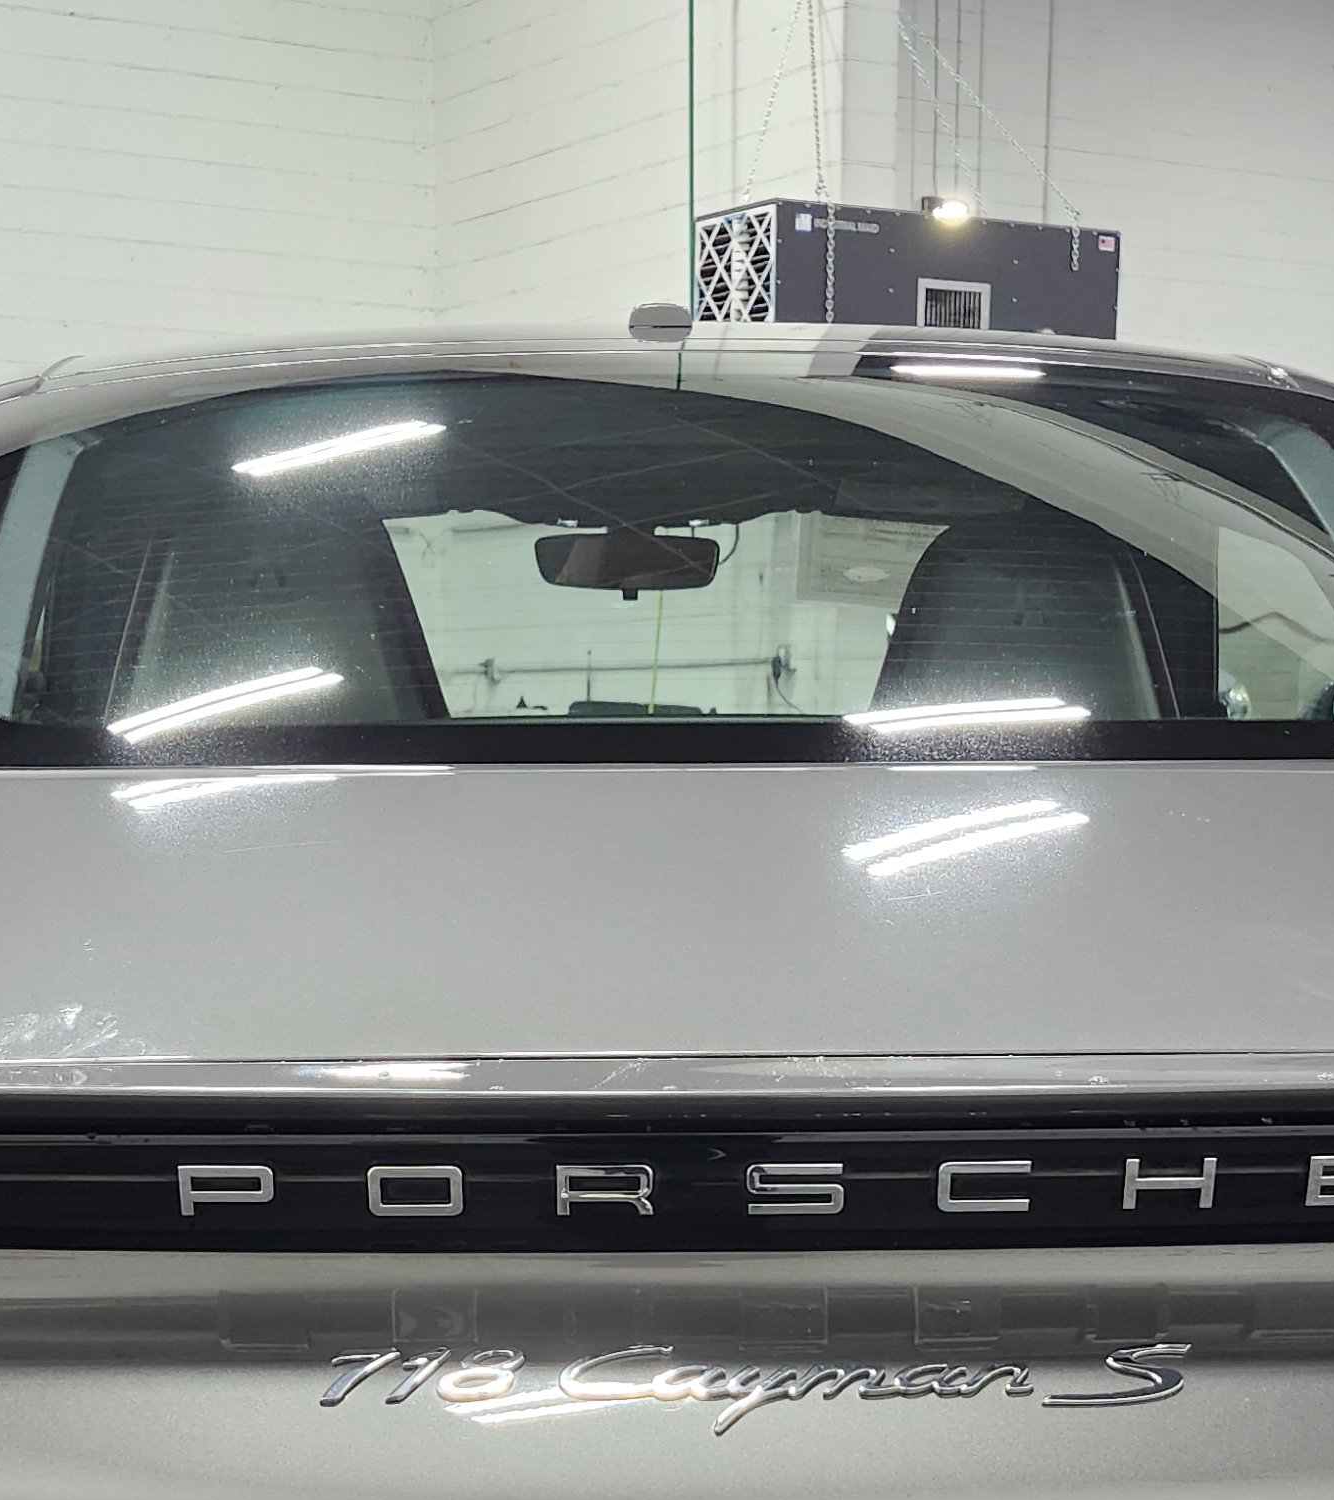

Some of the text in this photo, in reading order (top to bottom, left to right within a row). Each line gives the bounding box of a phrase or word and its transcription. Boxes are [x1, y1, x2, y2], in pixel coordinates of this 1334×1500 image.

[319, 1342, 1193, 1437] 718 Cayman S
